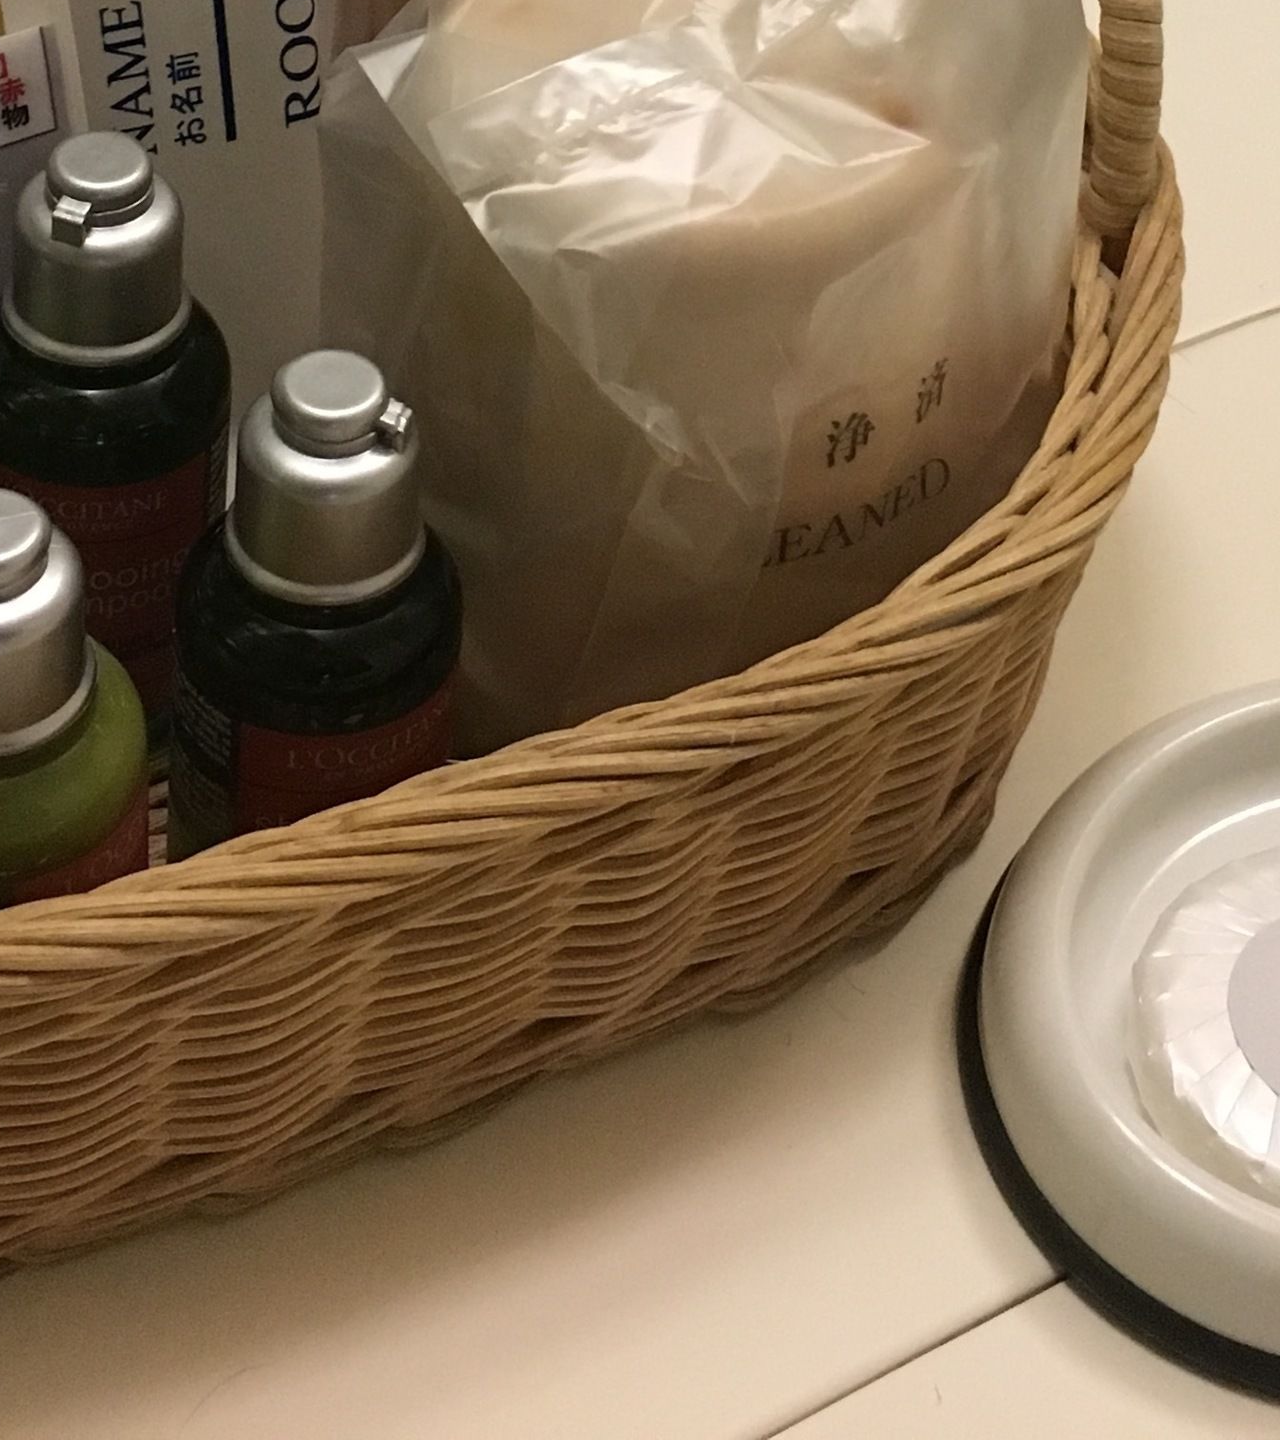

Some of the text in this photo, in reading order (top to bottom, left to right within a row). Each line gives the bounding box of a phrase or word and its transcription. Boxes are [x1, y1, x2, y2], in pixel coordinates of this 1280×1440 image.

[165, 51, 207, 147] お名前
[762, 457, 951, 569] EANED
